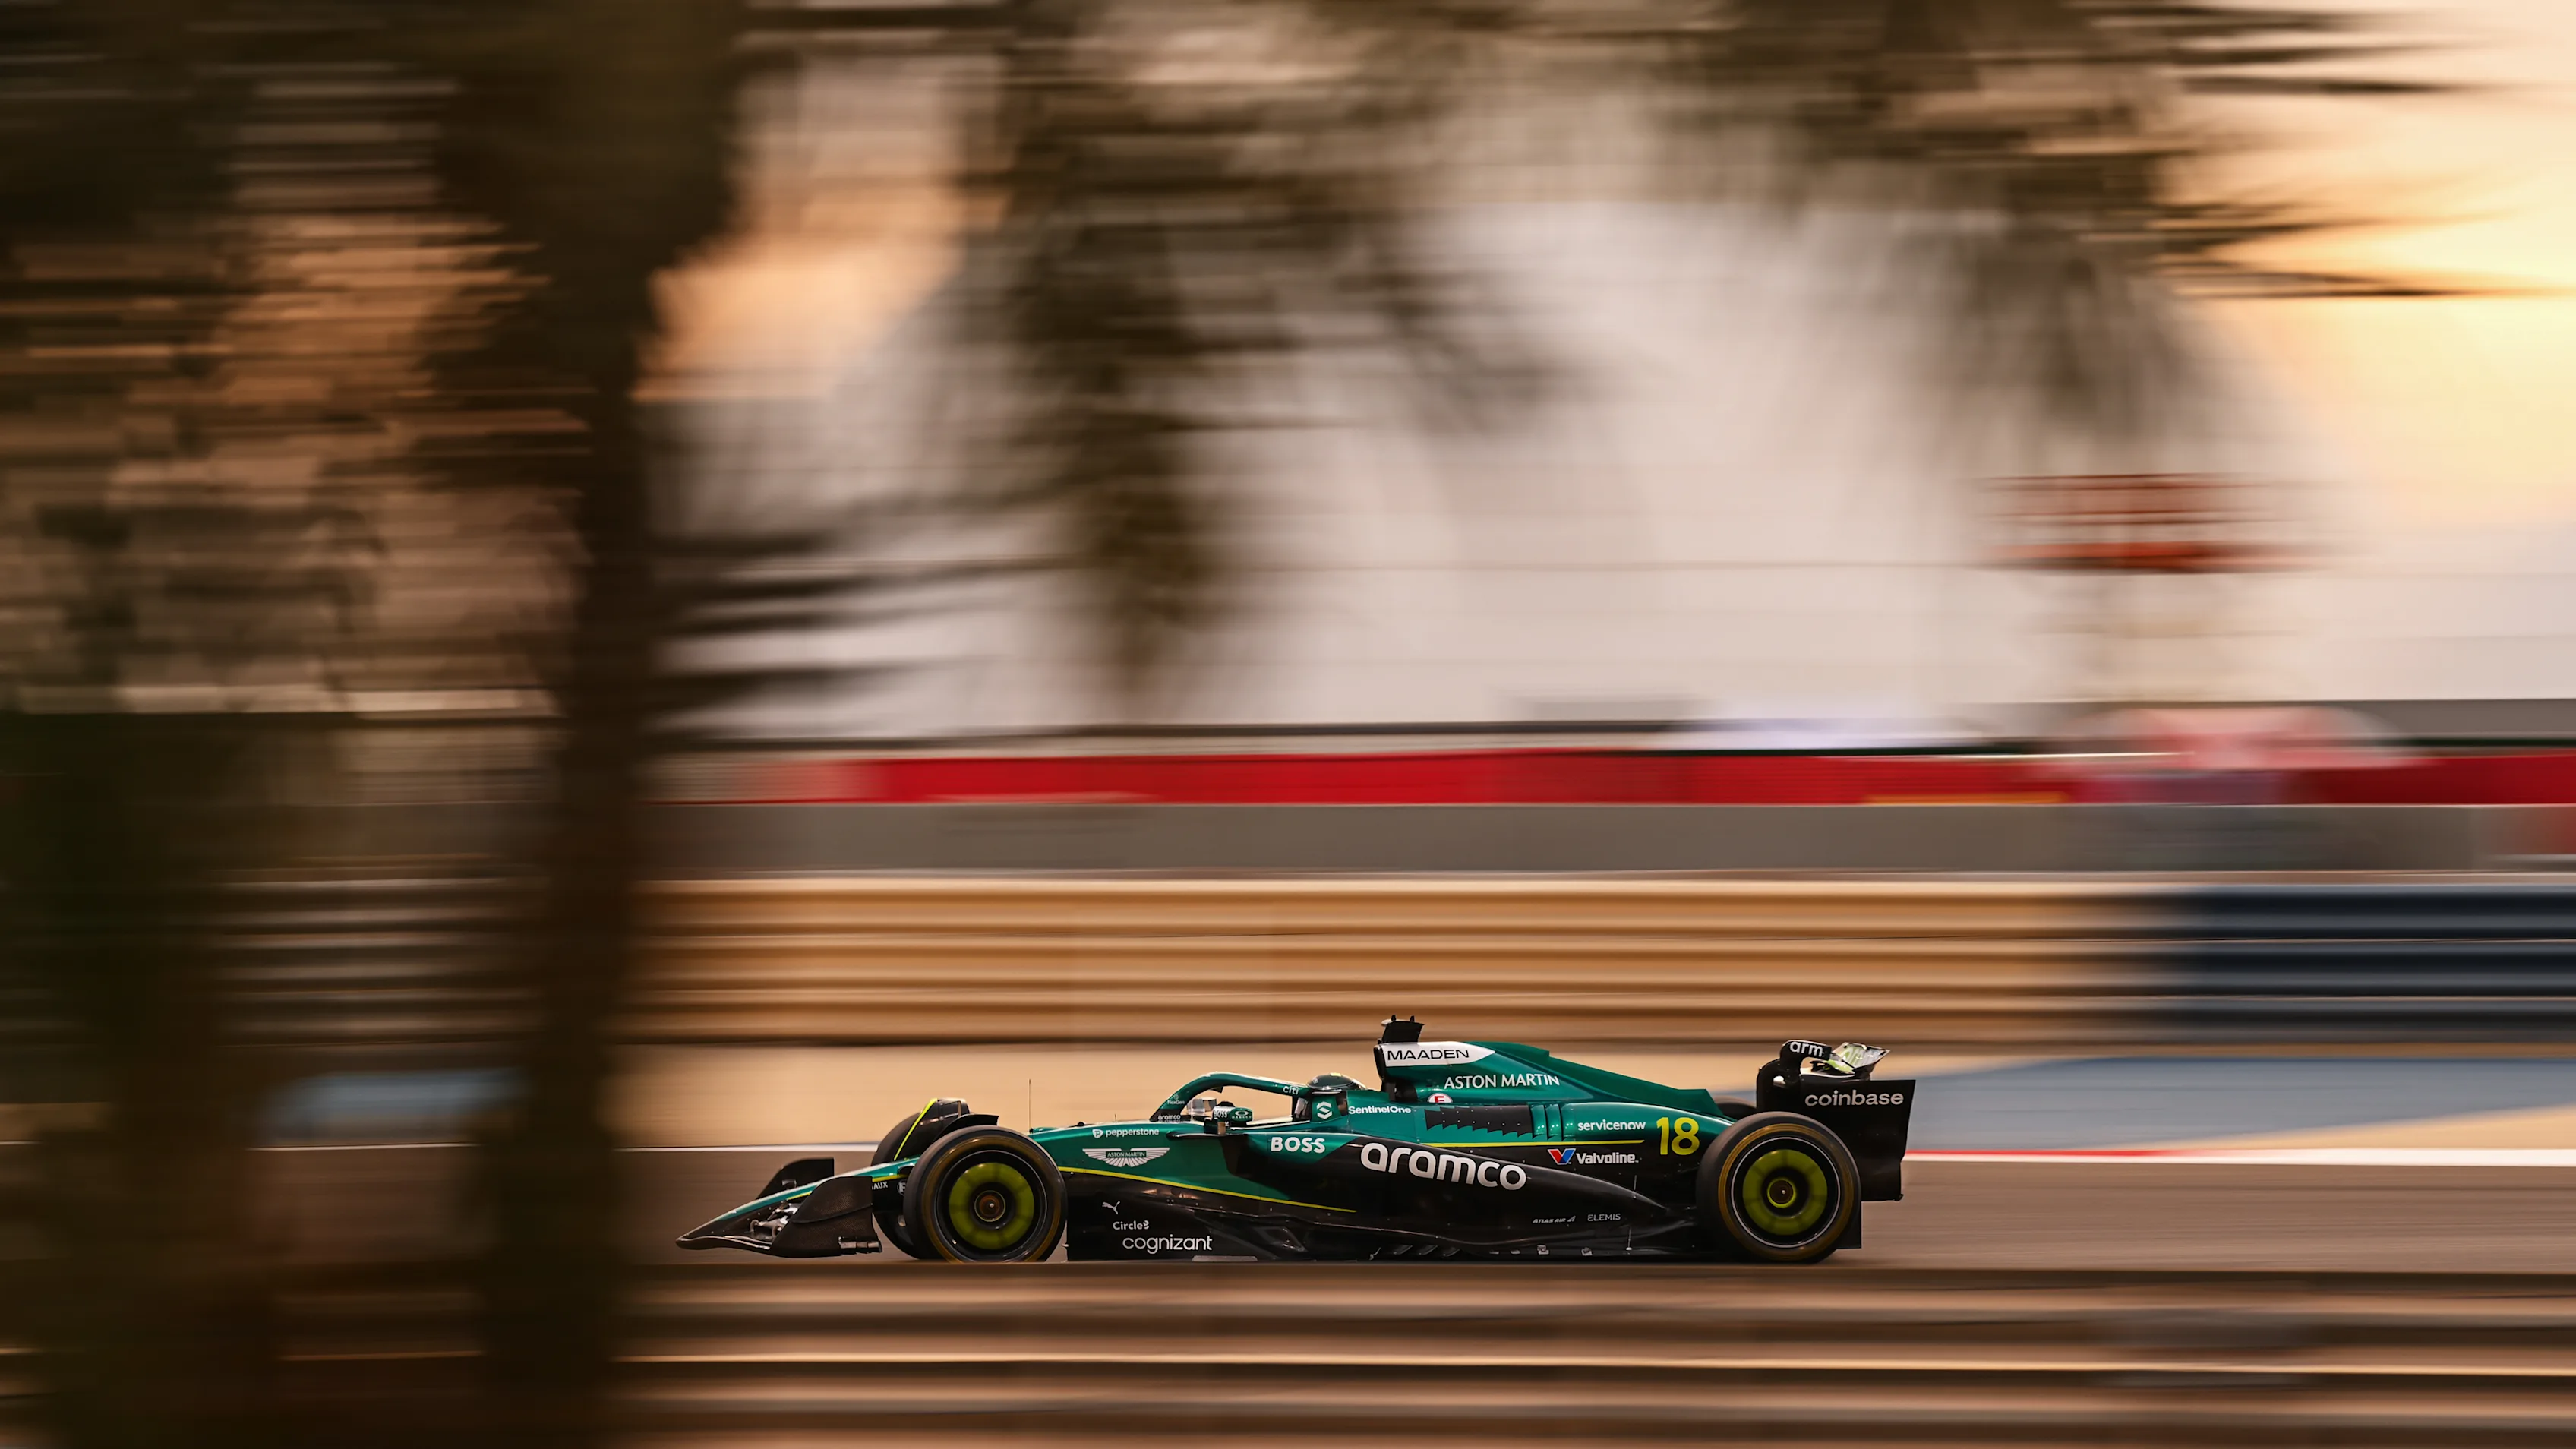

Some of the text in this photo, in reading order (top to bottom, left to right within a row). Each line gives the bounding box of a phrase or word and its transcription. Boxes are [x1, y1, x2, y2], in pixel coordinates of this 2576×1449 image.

[1387, 1050, 1470, 1060] MAADEN
[1790, 1041, 1823, 1057] arm
[1444, 1074, 1560, 1089] ASTON MARTIN
[1283, 1085, 1299, 1094] citi
[1805, 1089, 1904, 1106] coinbase
[1348, 1106, 1412, 1115] SentinelOne
[1577, 1119, 1646, 1131] servicenow
[1106, 1128, 1160, 1138] pepperstone
[1656, 1117, 1700, 1155] 18
[1271, 1136, 1326, 1154] BOSS
[1576, 1152, 1637, 1164] Valvoline
[1360, 1142, 1527, 1191] aramco
[872, 1181, 889, 1190] AUX
[1587, 1214, 1621, 1222] ELEMIS
[1122, 1234, 1213, 1254] cognizant
